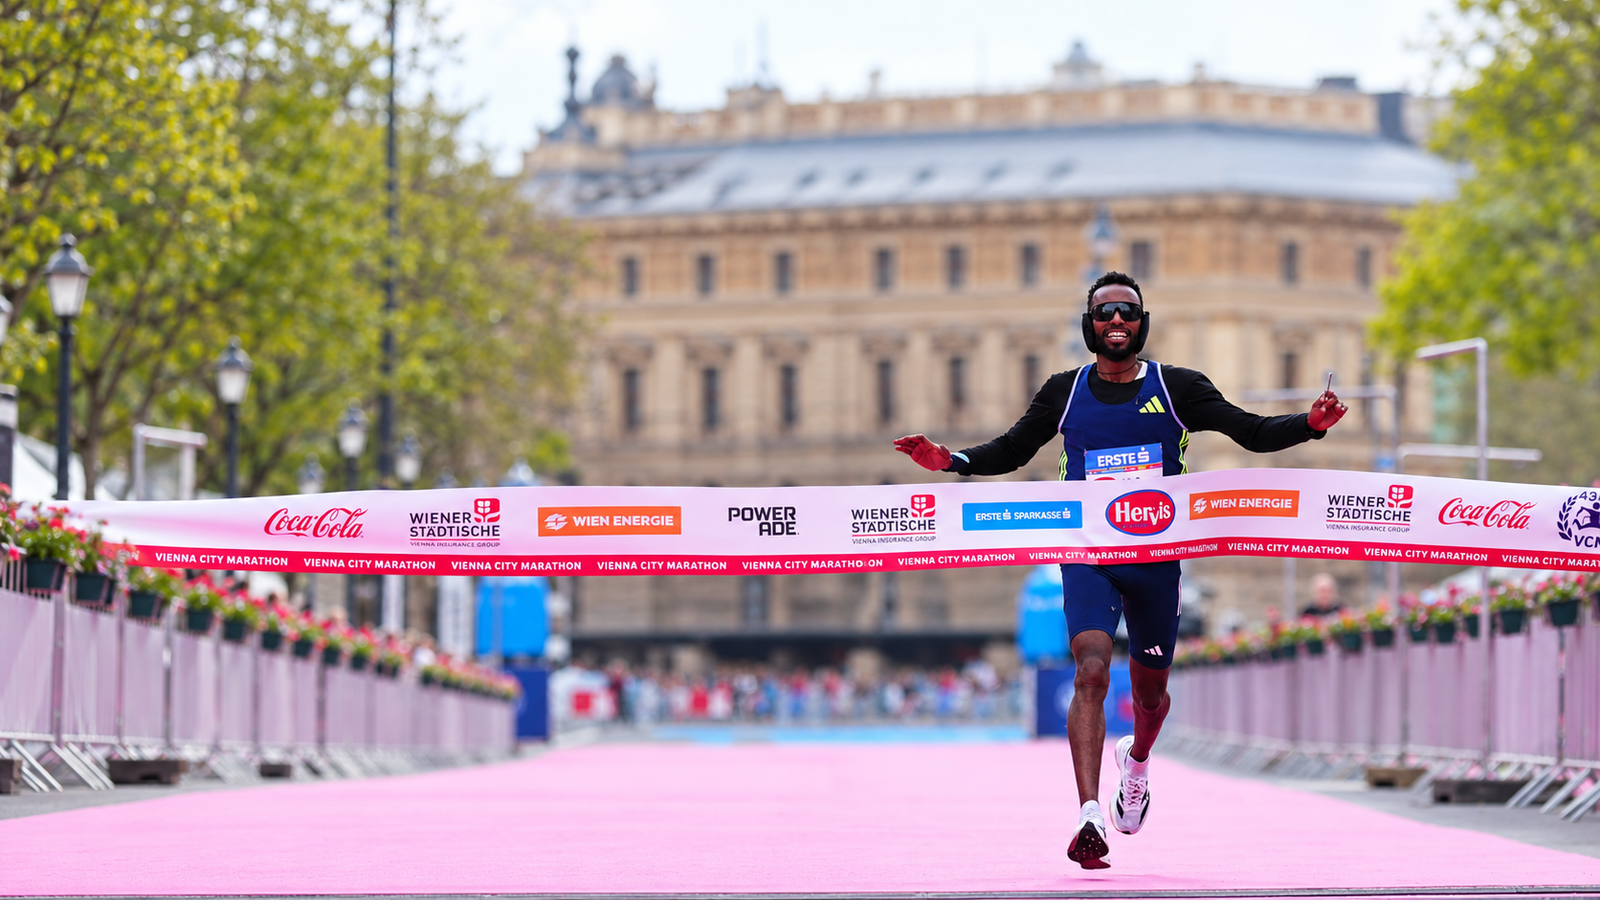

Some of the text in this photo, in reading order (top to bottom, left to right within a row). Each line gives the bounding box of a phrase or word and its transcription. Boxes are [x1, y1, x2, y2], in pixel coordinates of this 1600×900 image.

[1097, 452, 1137, 467] ERSTE
[1210, 498, 1293, 509] WIEN ENERGIE
[1328, 494, 1385, 508] WIENER
[410, 512, 472, 524] WIENER
[728, 506, 796, 522] POWER
[851, 507, 909, 520] WIENER
[975, 512, 1002, 521] ERSTE
[1014, 511, 1062, 521] SPARKASSE
[1115, 501, 1171, 526] Hervis
[1326, 507, 1412, 522] STÄDTISCHE
[1438, 497, 1538, 530] Coca-Cola
[264, 507, 369, 539] Coca-Cola
[572, 515, 674, 527] WIEN ENERGIE
[851, 519, 936, 533] STÄDTISCHE
[410, 525, 500, 537] STÄDTISCHE
[1227, 542, 1350, 555] VIENNA CITY MARATHON
[1364, 547, 1488, 561] VIENNA CITY MARATHON
[155, 552, 289, 566] VIENNA CITY MARATHON
[897, 553, 1015, 566] VIENNA CITY MARATHON
[1028, 551, 1138, 560] VIENNA CITY MARATHON
[1501, 554, 1540, 564] VIENNA
[1542, 556, 1565, 566] CITY
[303, 558, 436, 570] VIENNA CITY MARATHON
[451, 561, 582, 571] VIENNA CITY MARATHON
[597, 561, 727, 570] VIENNA CITY MARATHON
[742, 561, 782, 570] VIENNA
[784, 560, 808, 569] CITY
